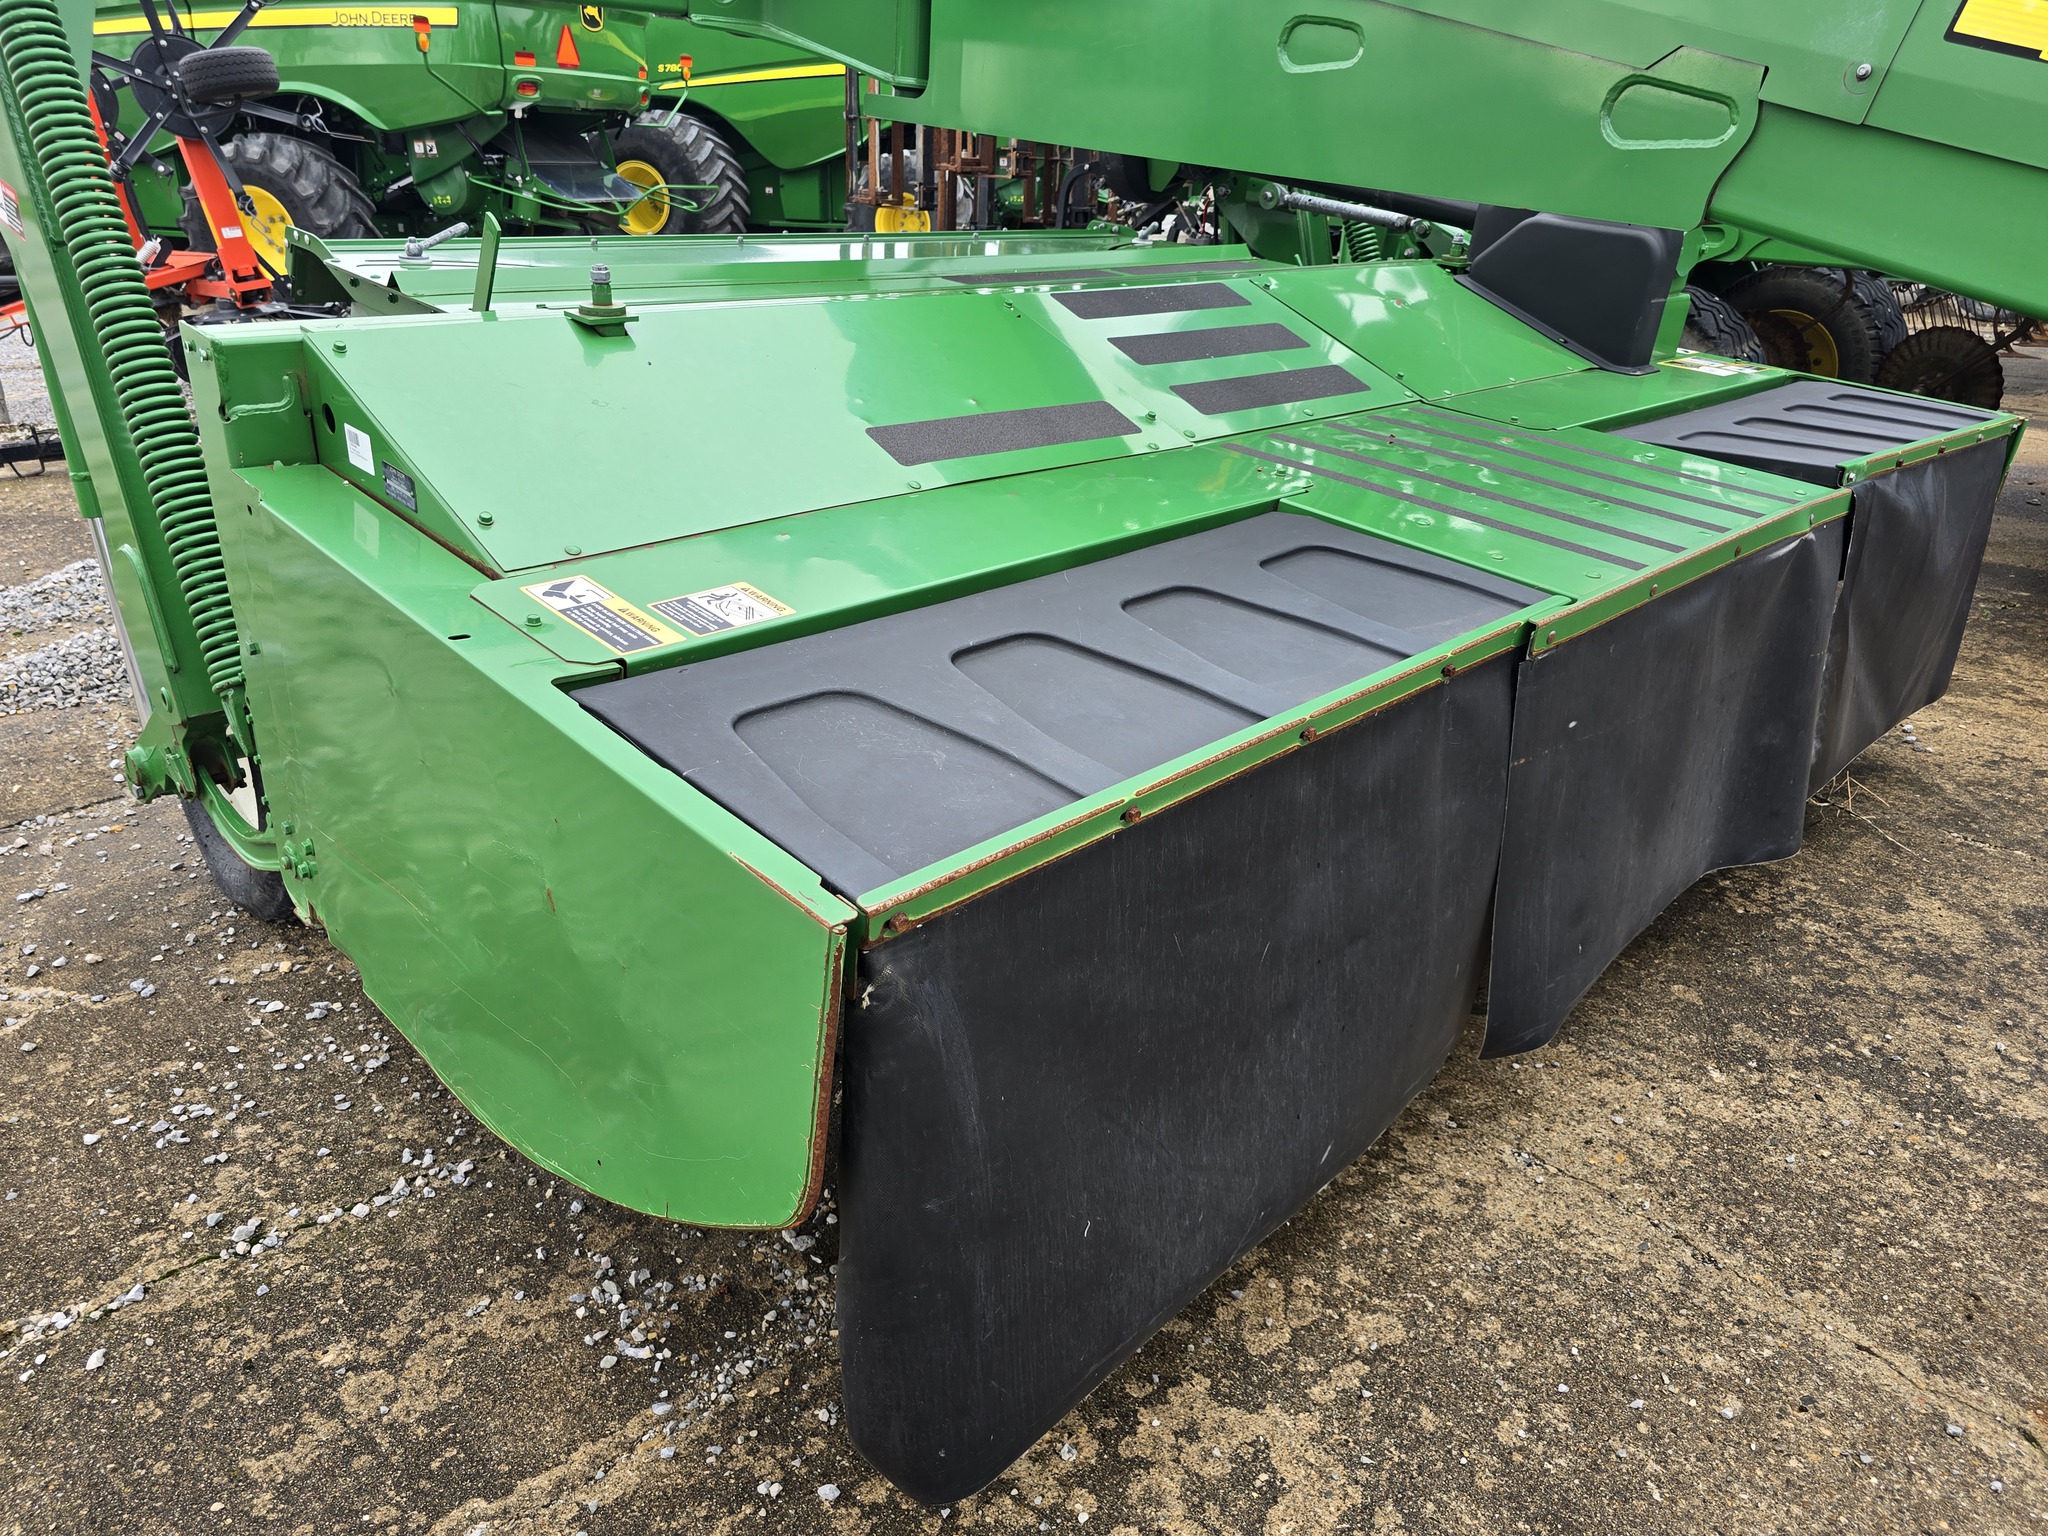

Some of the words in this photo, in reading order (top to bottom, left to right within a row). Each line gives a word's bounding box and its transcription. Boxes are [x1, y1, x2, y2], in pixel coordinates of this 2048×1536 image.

[331, 11, 368, 24] JOHN
[748, 589, 787, 612] WARNING
[625, 611, 661, 633] WARNING
